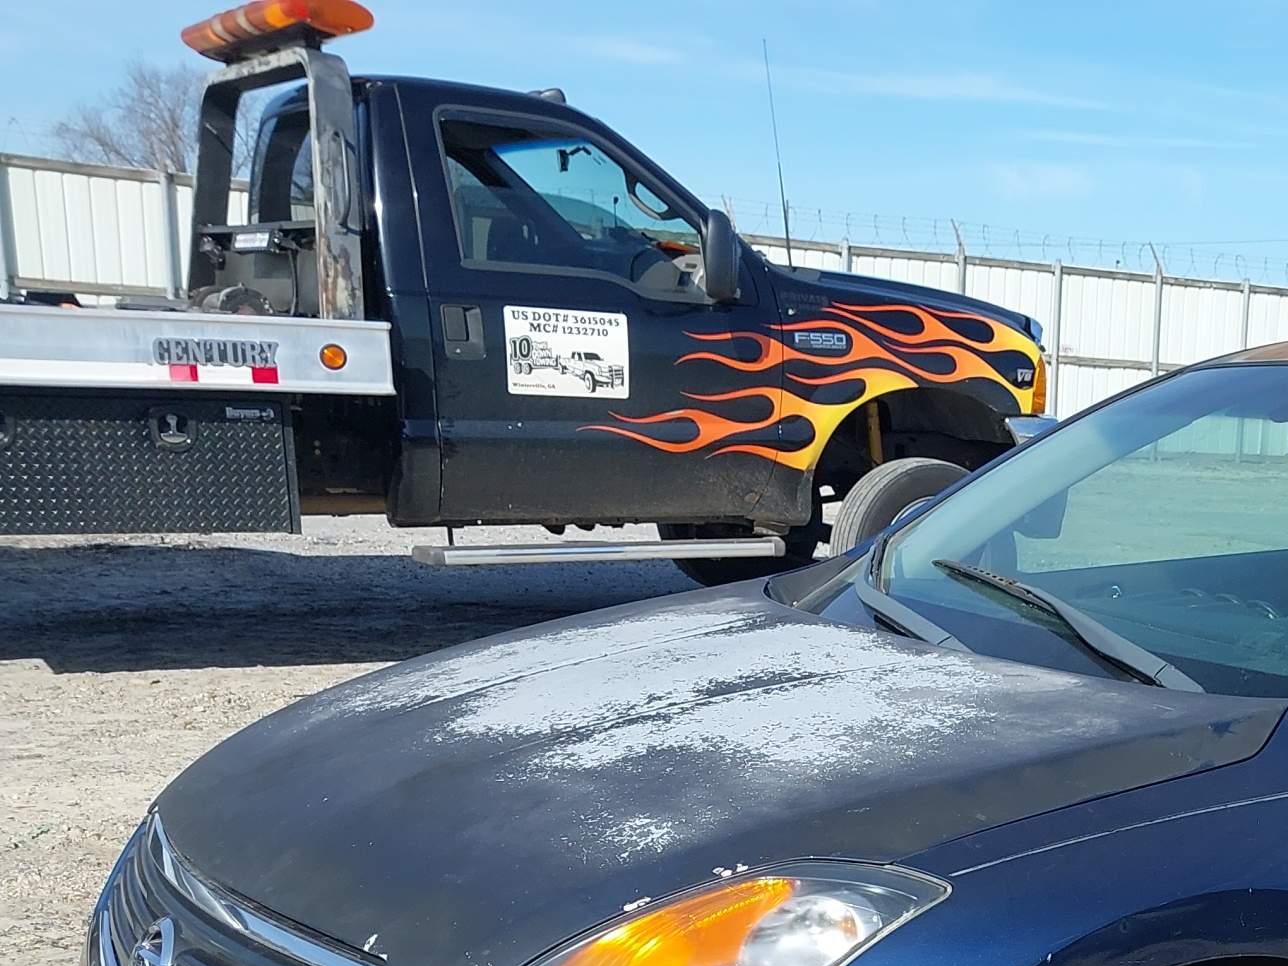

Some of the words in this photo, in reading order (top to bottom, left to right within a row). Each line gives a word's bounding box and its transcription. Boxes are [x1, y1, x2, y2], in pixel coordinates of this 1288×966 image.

[511, 310, 528, 320] US
[532, 311, 568, 323] DOT#
[572, 315, 620, 327] 3615045
[529, 322, 558, 333] MC#
[562, 326, 609, 337] 1232710
[152, 337, 279, 368] CENTURY
[511, 336, 531, 361] 10
